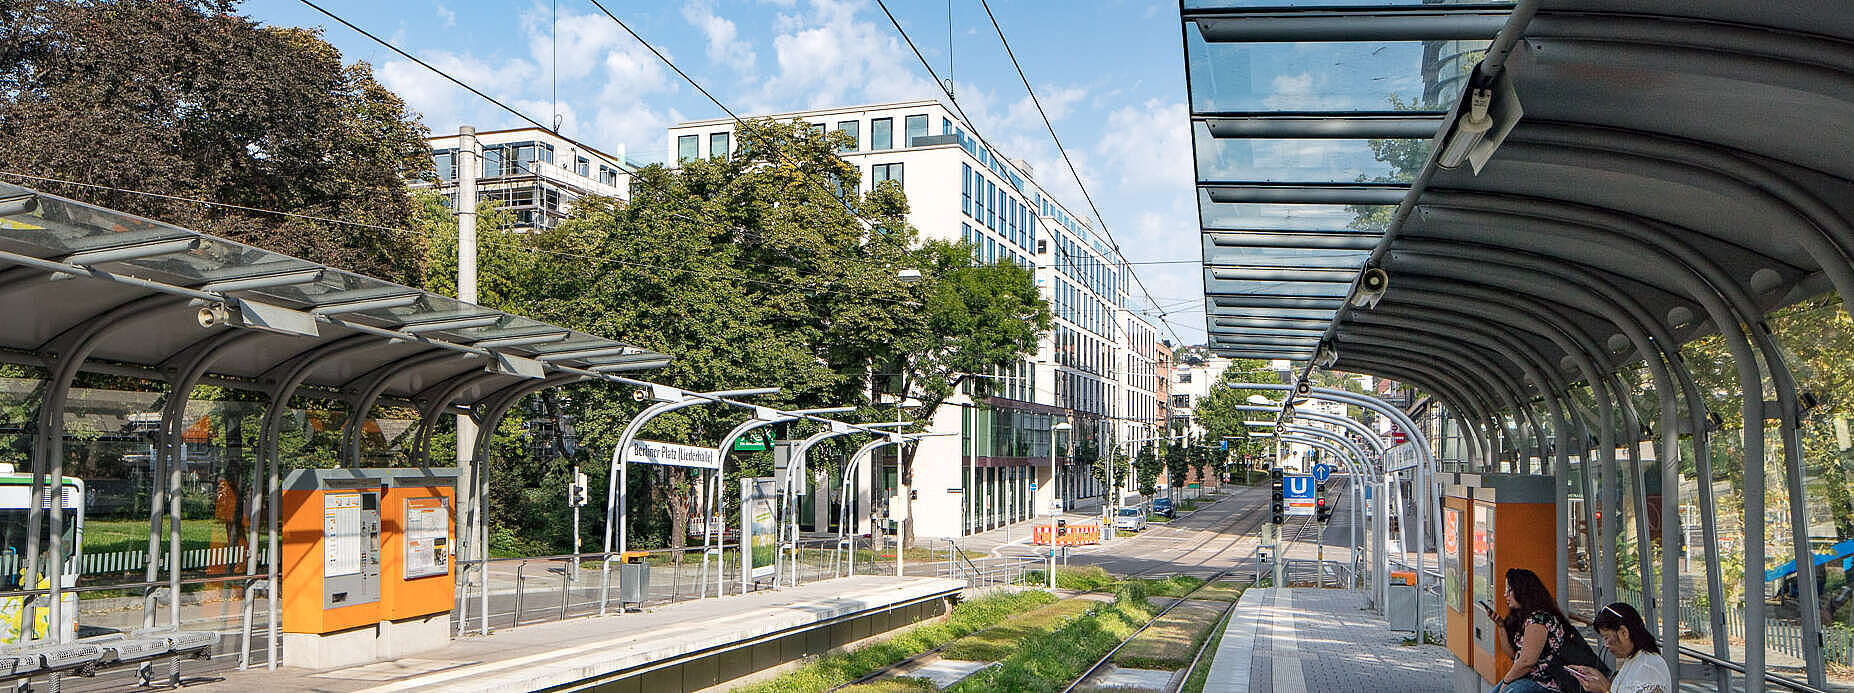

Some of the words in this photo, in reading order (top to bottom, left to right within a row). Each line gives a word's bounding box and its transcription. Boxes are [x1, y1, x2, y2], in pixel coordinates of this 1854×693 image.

[634, 443, 660, 458] Berliner
[661, 446, 677, 460] Platz
[1290, 478, 1307, 494] U
[1259, 554, 1267, 562] H
